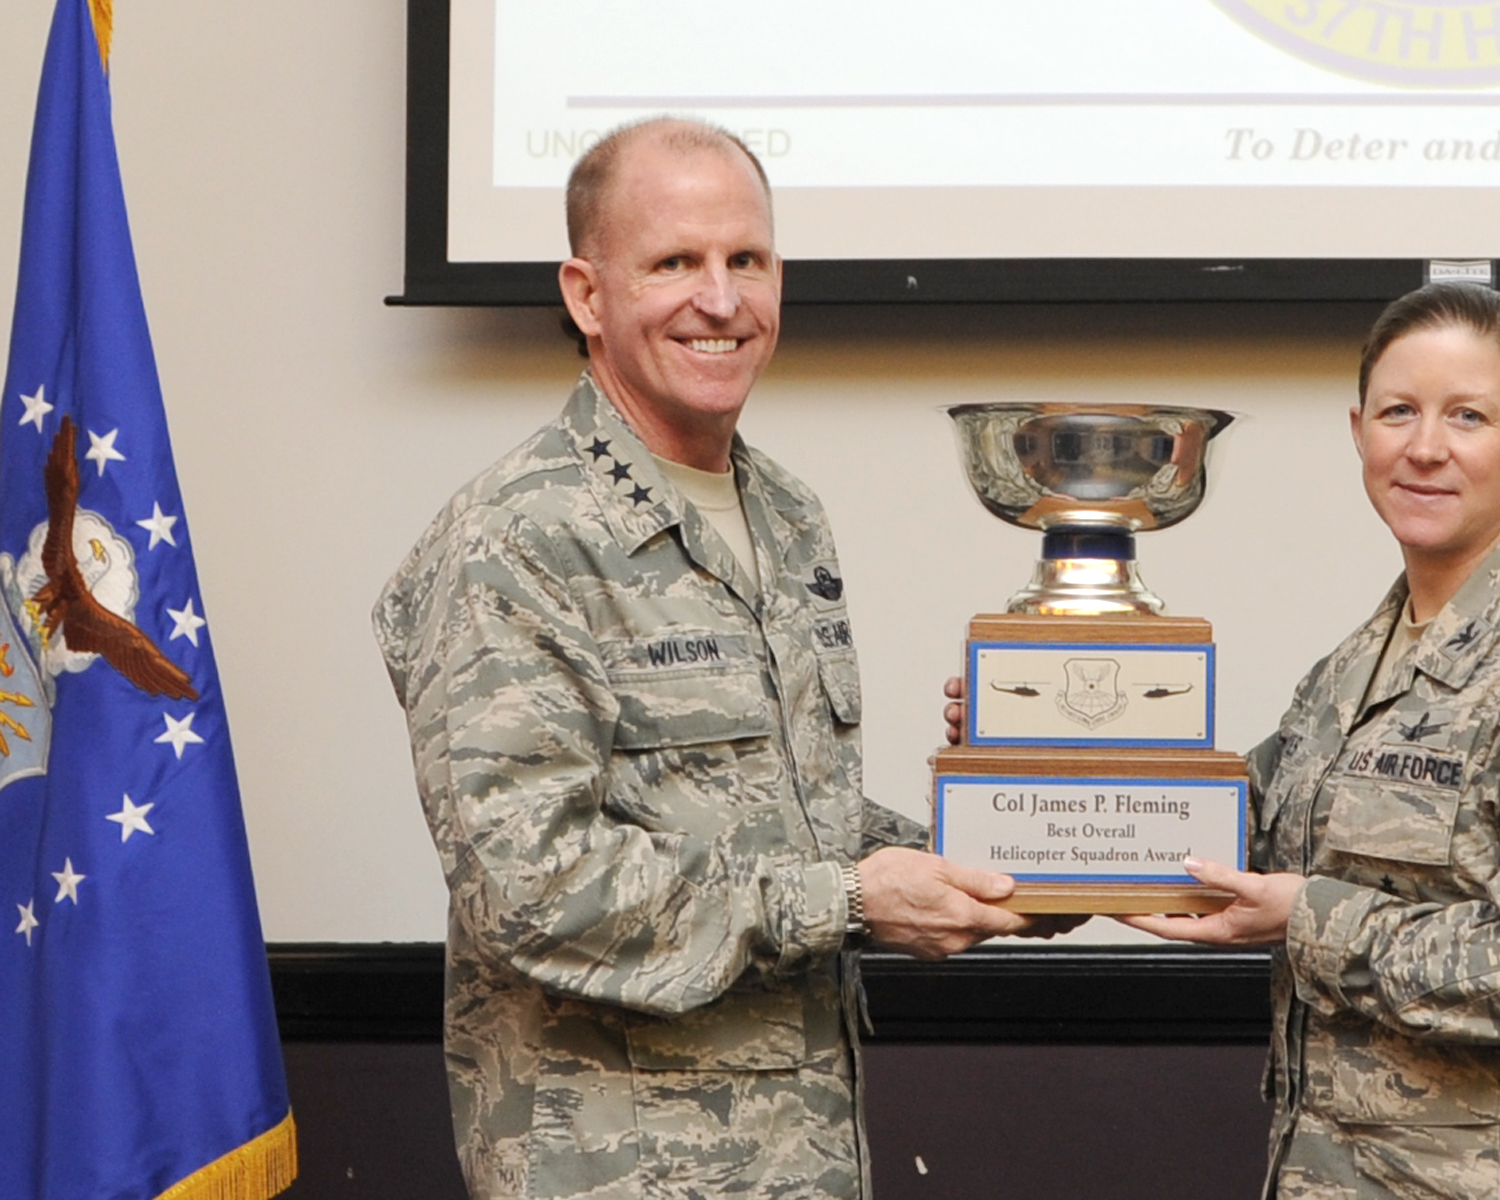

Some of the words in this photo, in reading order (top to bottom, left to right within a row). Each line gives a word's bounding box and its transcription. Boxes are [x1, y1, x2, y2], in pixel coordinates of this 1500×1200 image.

[1225, 129, 1274, 161] To
[1289, 129, 1408, 161] Deter
[647, 638, 721, 666] WILSON
[1372, 753, 1400, 777] AIR
[1400, 755, 1464, 786] FORCE
[992, 792, 1025, 812] Col
[1030, 794, 1087, 817] James
[1095, 795, 1107, 813] P.
[1115, 795, 1190, 820] Fleming
[1047, 823, 1077, 838] Best
[1082, 824, 1136, 839] Overall
[990, 845, 1066, 865] Helicopter
[1071, 846, 1139, 866] Squadron
[1144, 848, 1191, 863] Award
